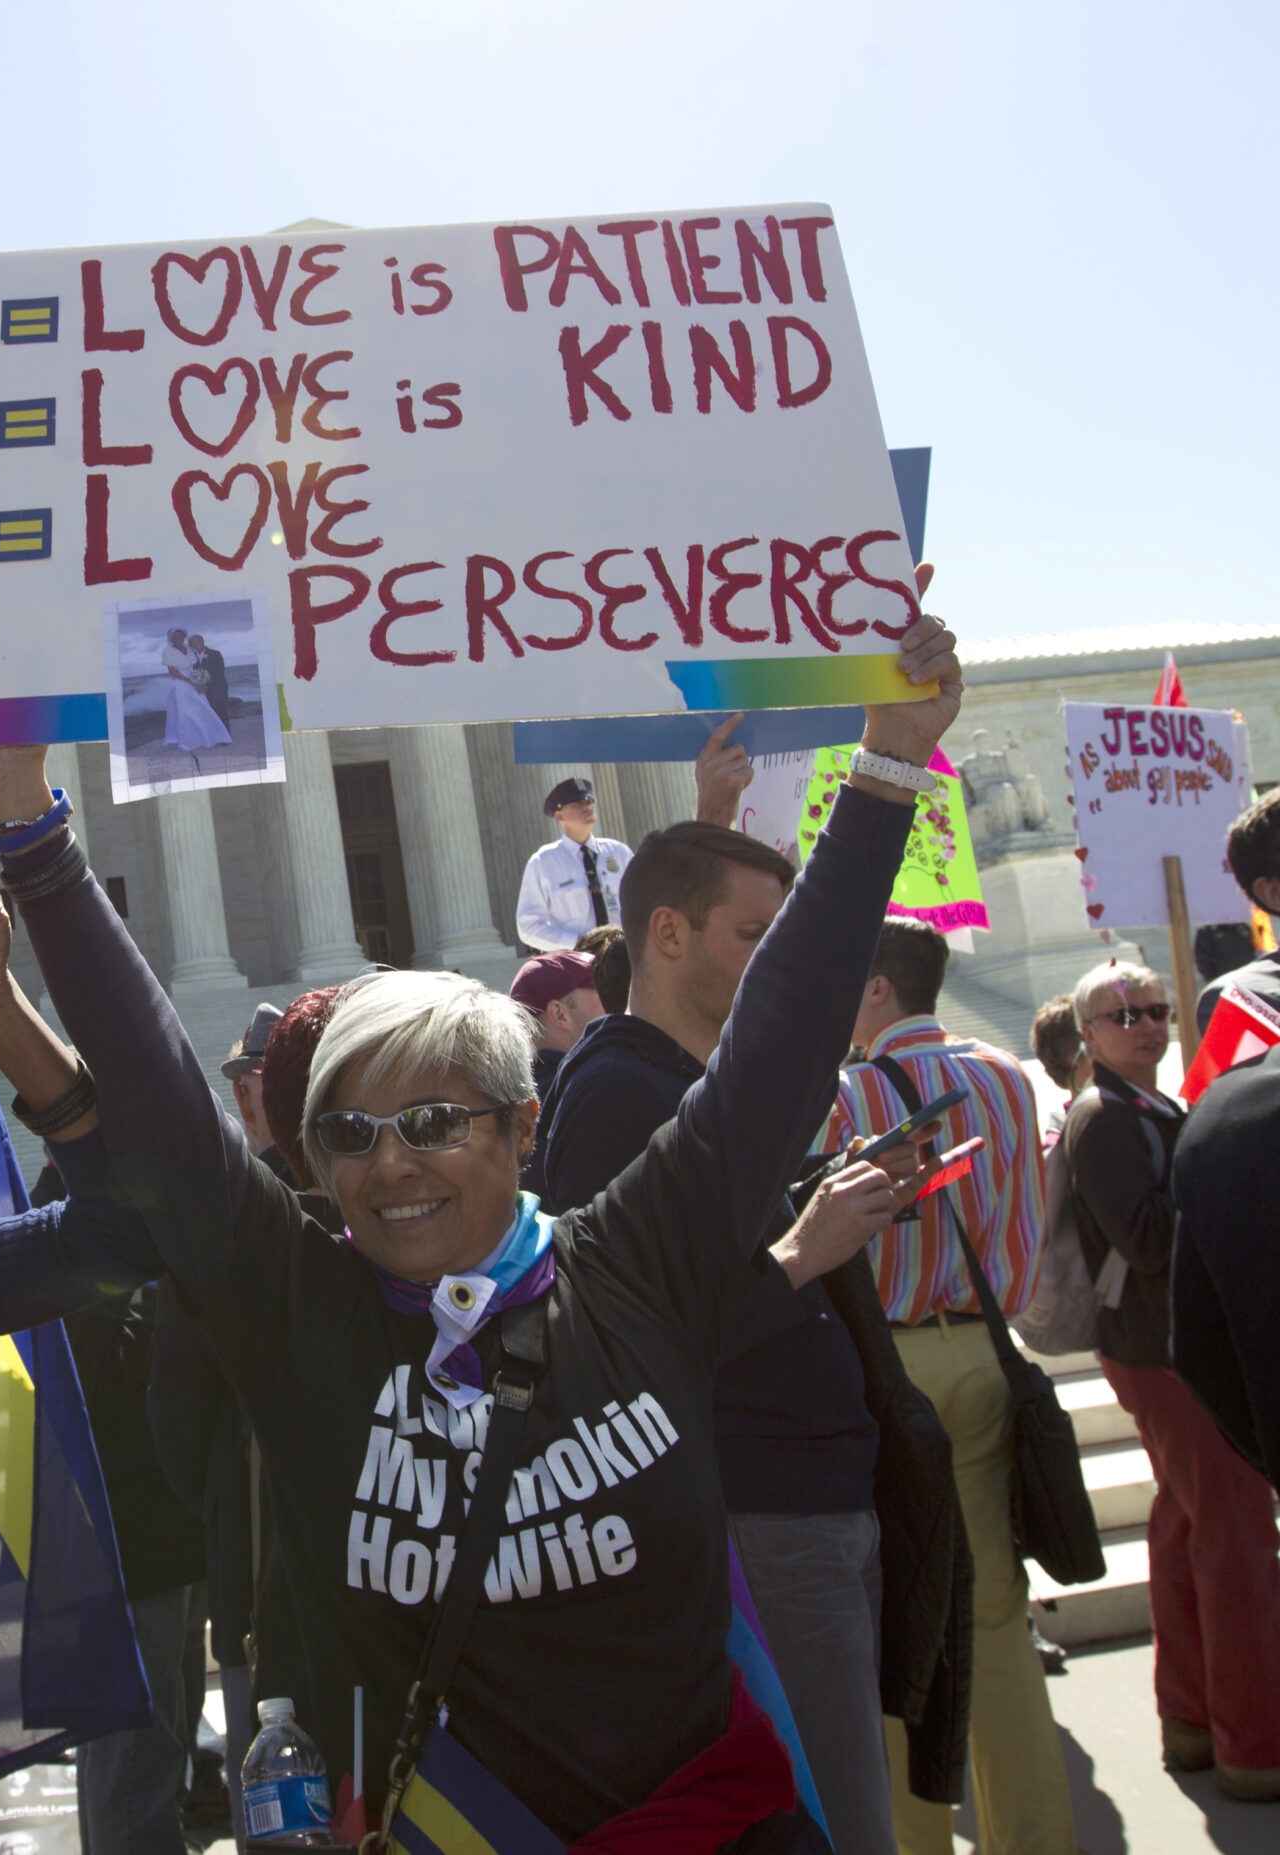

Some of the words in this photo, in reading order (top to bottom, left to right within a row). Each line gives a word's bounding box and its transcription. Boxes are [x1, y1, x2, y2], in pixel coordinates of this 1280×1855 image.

[80, 244, 352, 353] LOVE
[384, 256, 453, 317] is
[493, 214, 835, 312] PATIENT
[81, 350, 362, 467] LOVE
[395, 379, 463, 433] is
[558, 316, 832, 426] KIND
[83, 461, 384, 586] LOVE
[288, 530, 922, 681] PERSEVERES
[1100, 707, 1205, 762] JESUS
[355, 1425, 447, 1530] My
[347, 1510, 456, 1605] Hot
[483, 1513, 637, 1604] Wife
